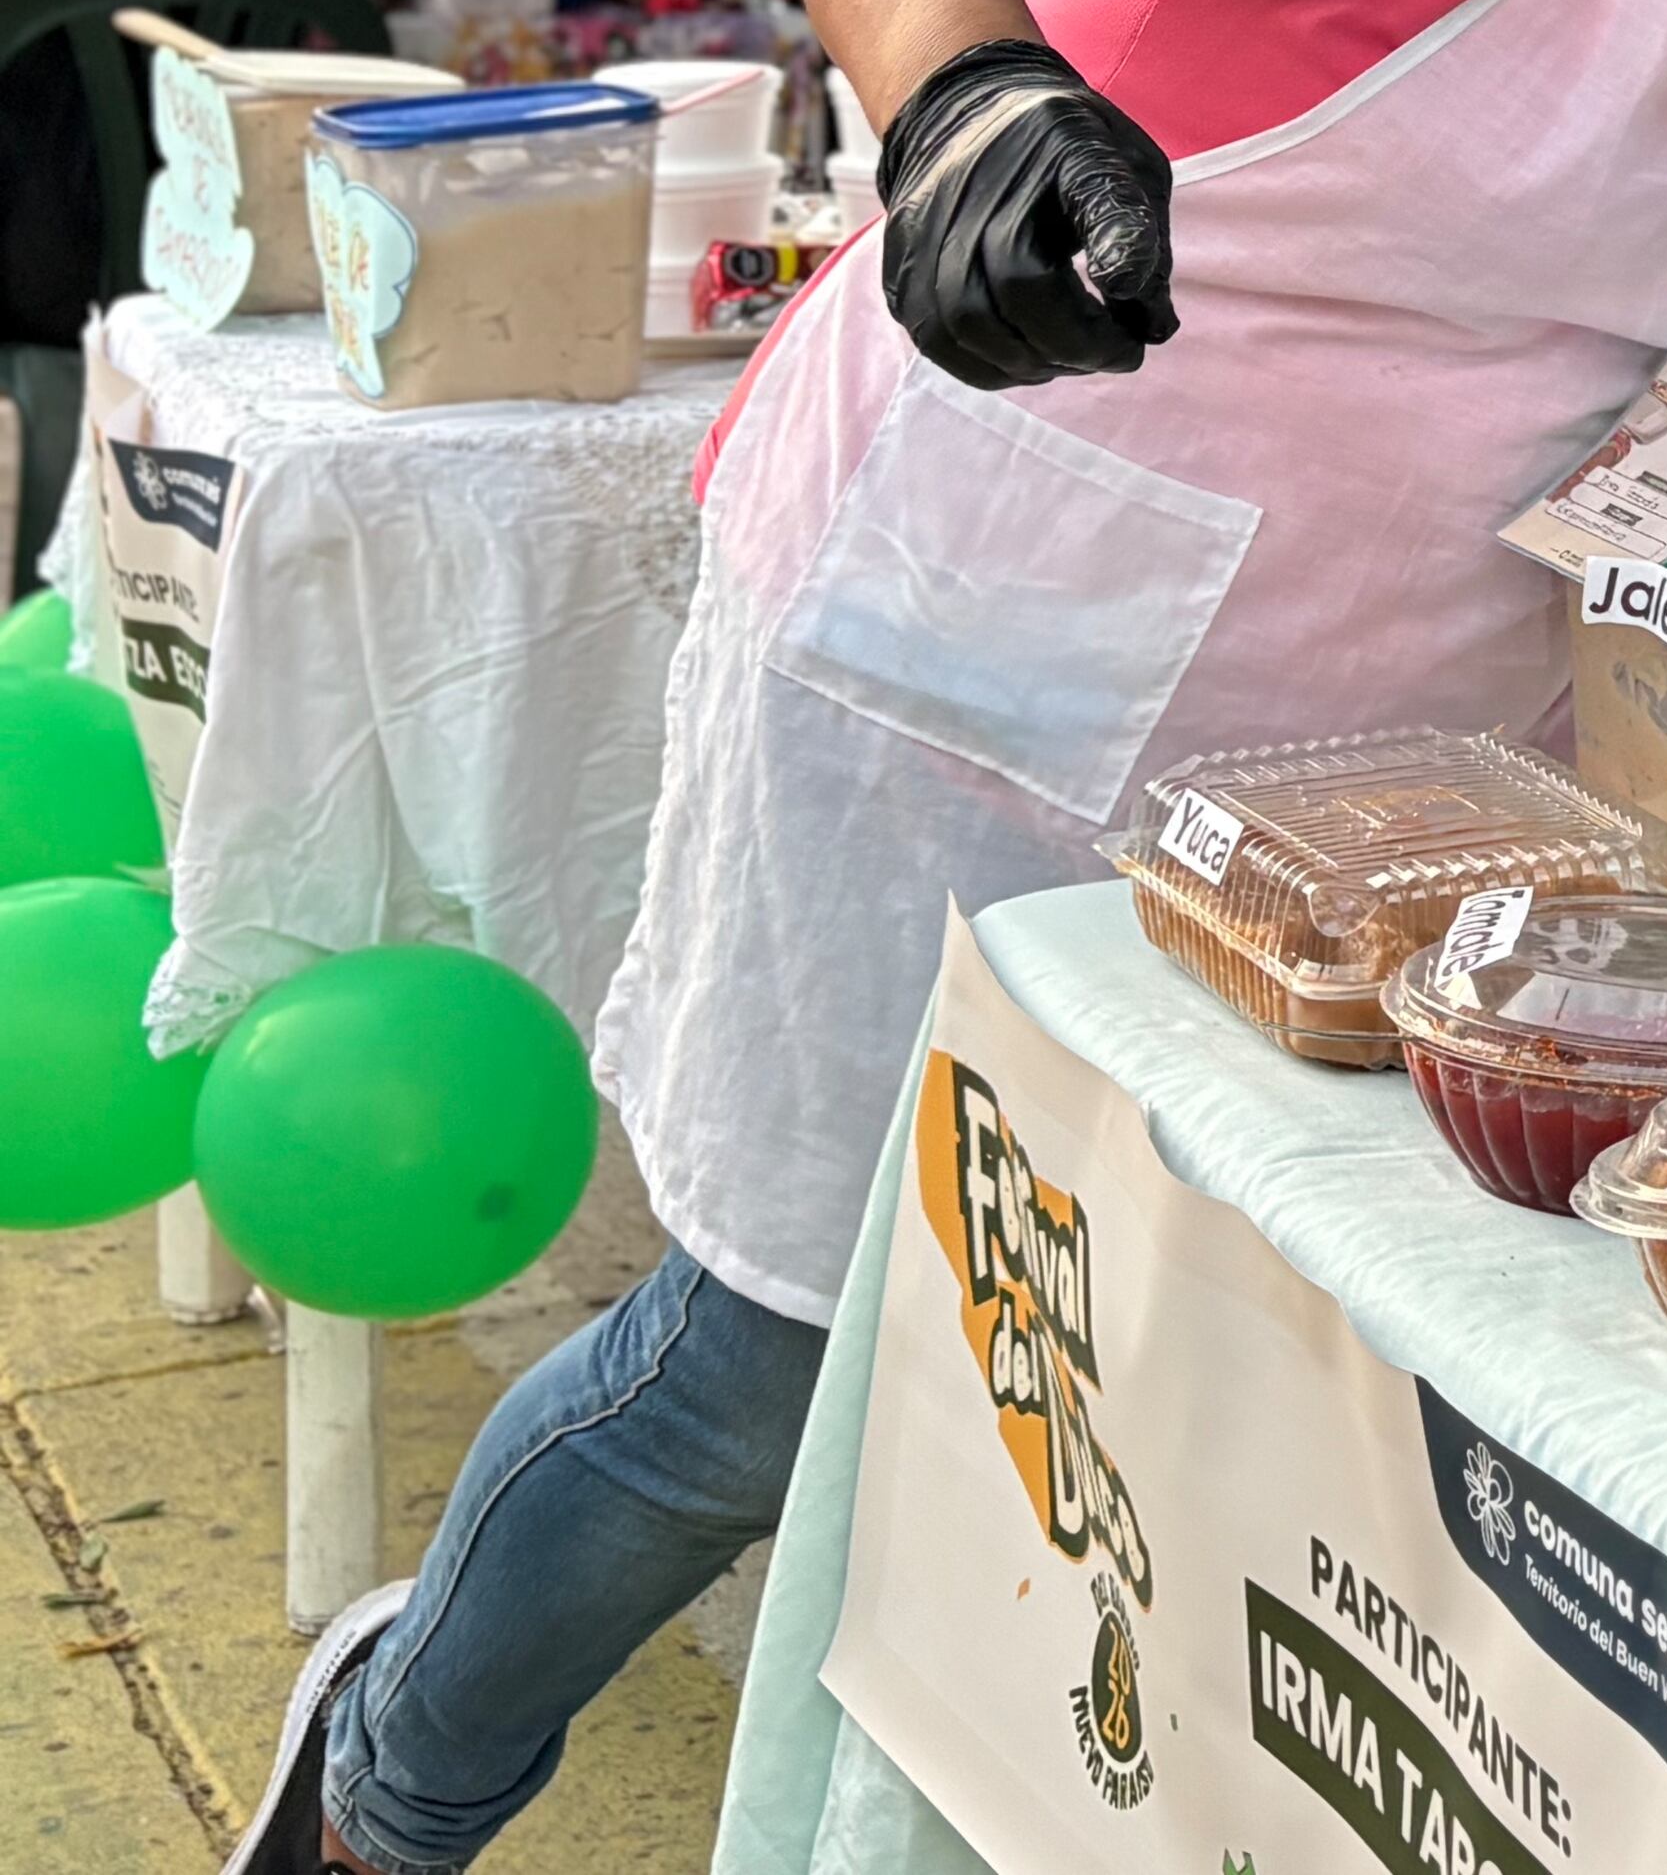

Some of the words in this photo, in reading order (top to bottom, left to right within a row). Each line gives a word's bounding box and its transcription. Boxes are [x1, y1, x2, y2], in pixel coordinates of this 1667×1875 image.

[1174, 796, 1231, 873] Yuca
[991, 1295, 1044, 1407] del
[1038, 1328, 1149, 1590] Dulce
[1523, 1499, 1635, 1624] comuna
[1524, 1553, 1588, 1632] Territorio
[1589, 1620, 1614, 1659] del
[1615, 1638, 1659, 1693] Buen
[1259, 1630, 1385, 1815] IRMA
[1310, 1534, 1572, 1859] PARTICIPANTE:
